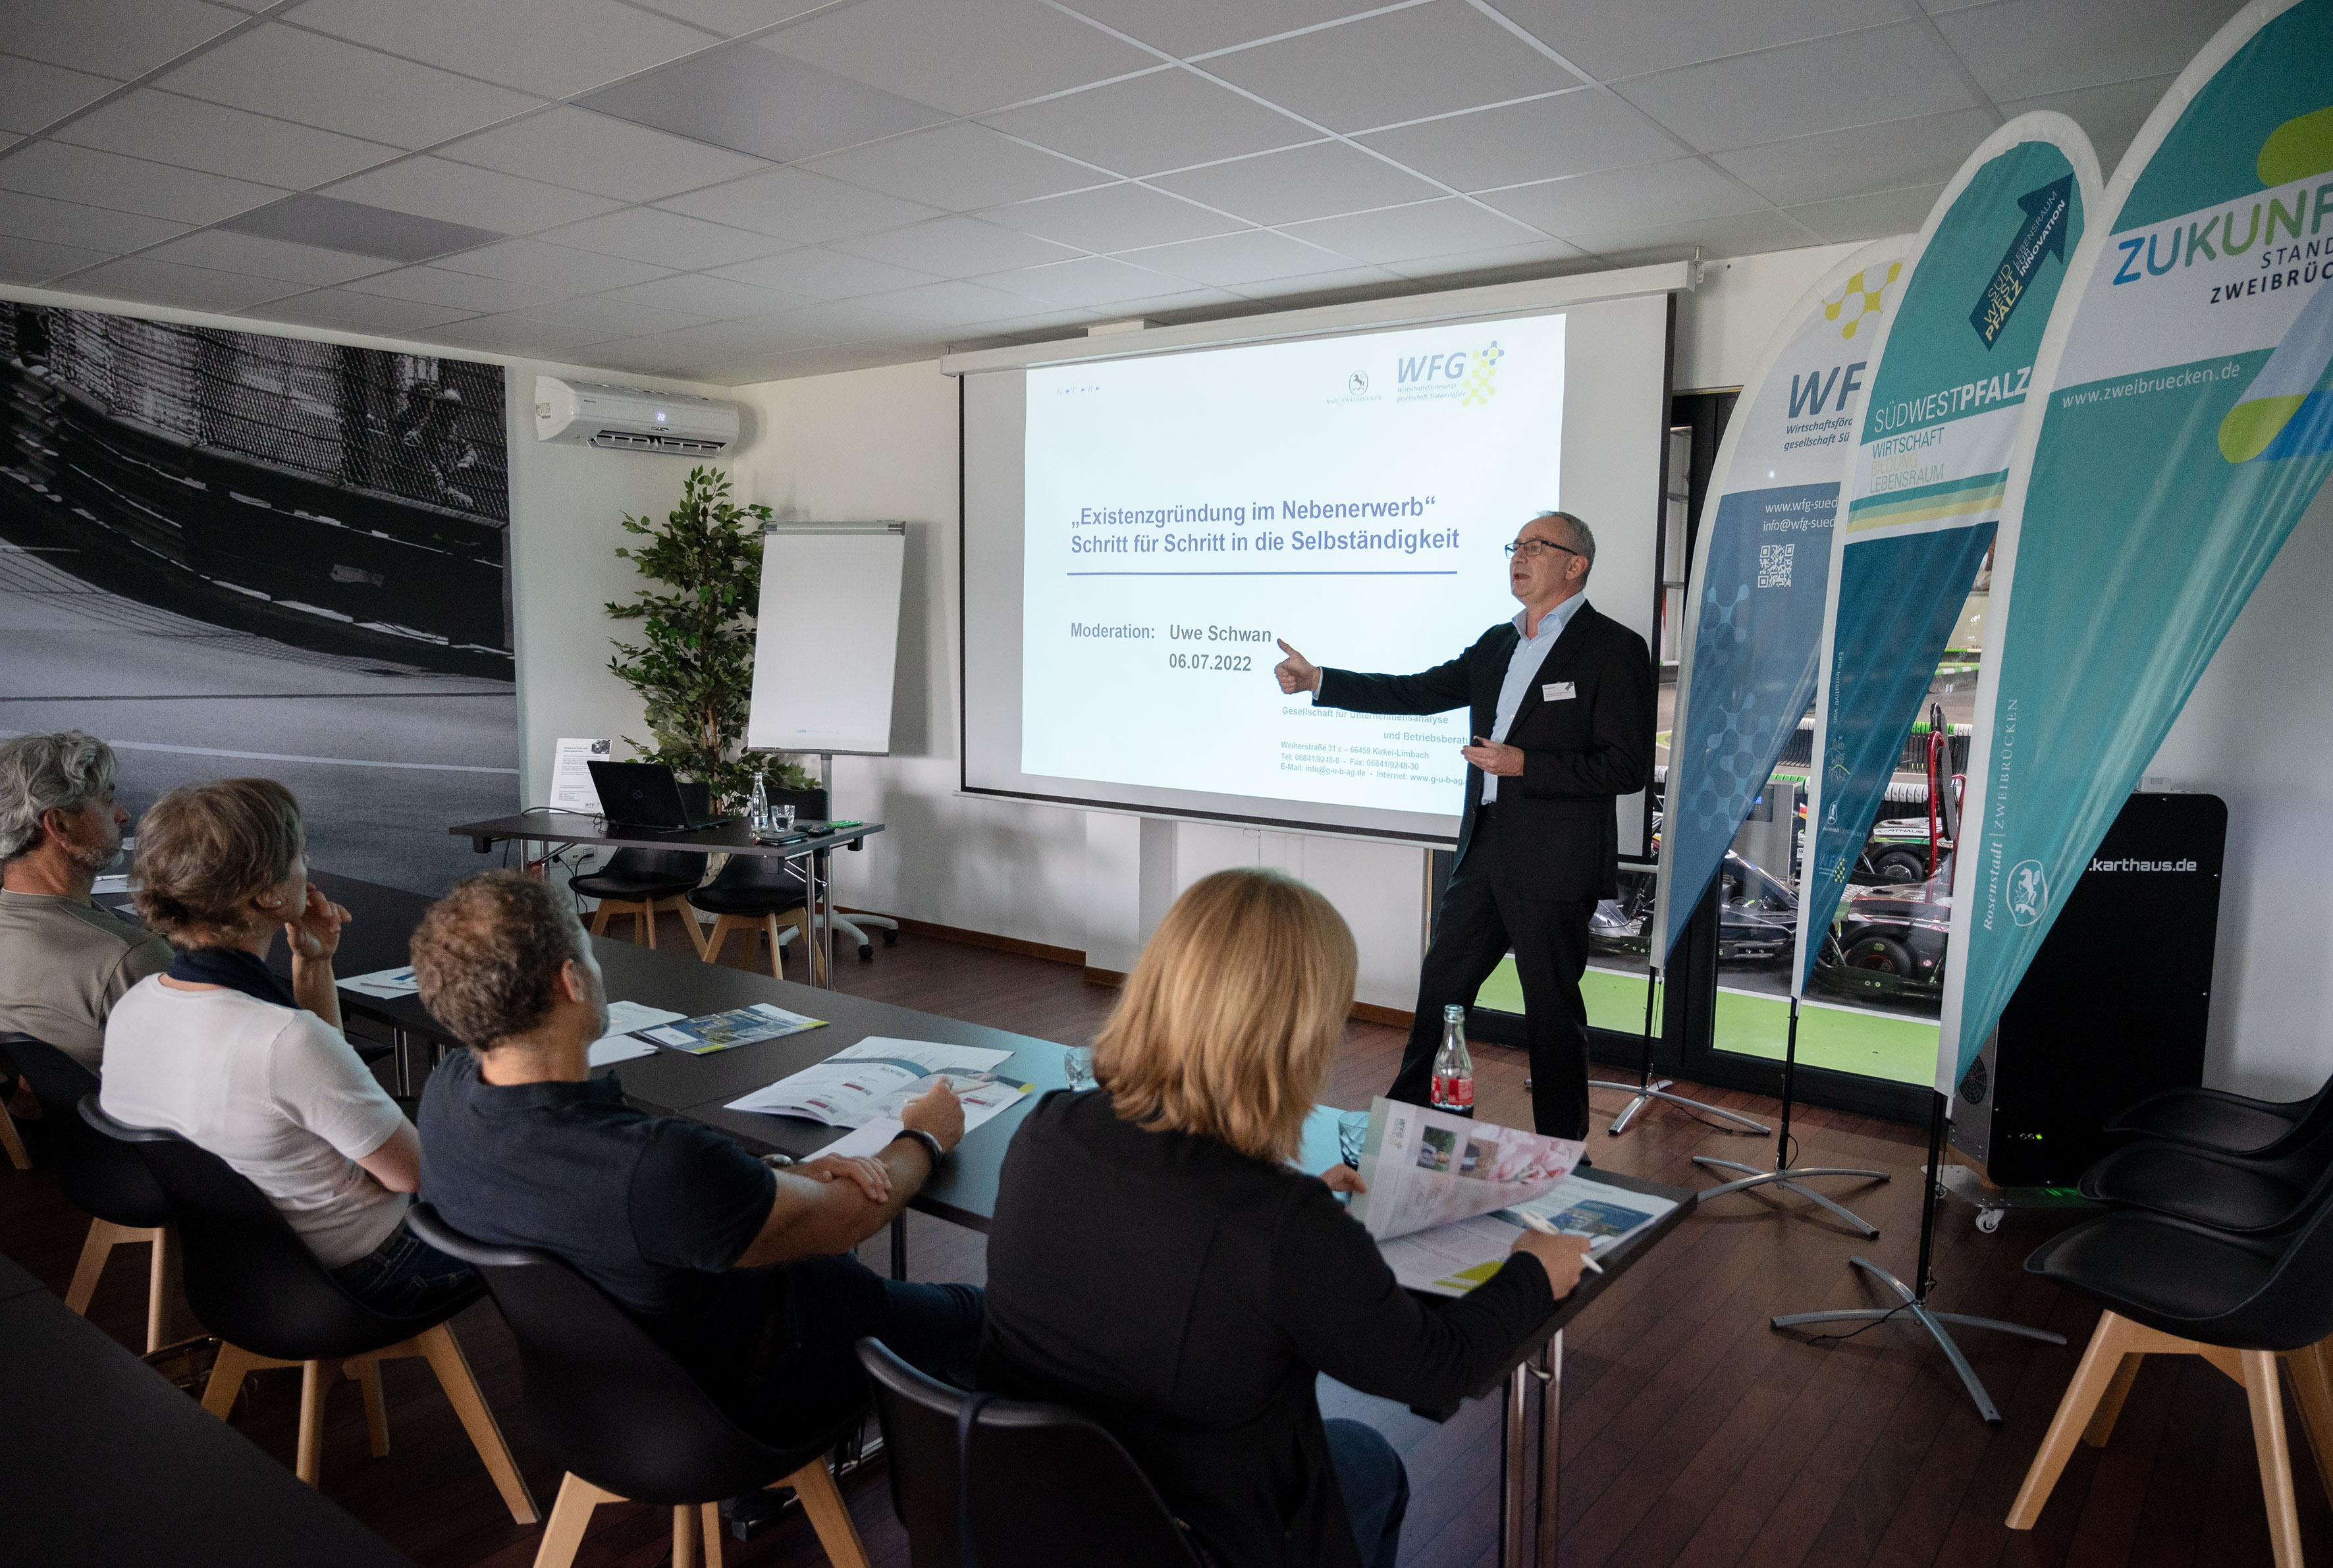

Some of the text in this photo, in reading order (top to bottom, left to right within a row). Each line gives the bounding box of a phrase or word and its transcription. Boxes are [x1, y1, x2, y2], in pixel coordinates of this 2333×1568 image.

[2012, 190, 2058, 266] LEBENSRAUM
[2019, 199, 2066, 277] INNOVATION
[2112, 183, 2333, 286] ZUKUNF
[2015, 248, 2031, 272] FÜR
[2261, 236, 2333, 269] STAND
[1983, 271, 2016, 323] WEST
[1987, 263, 2011, 302] SÜD
[2210, 261, 2333, 304] ZWEIBRÜC
[1985, 279, 2023, 342] PFALZ
[1397, 352, 1467, 384] WFG
[1788, 361, 1867, 419] WF
[1874, 366, 2031, 433] SÜDWESTPFALZ
[2062, 362, 2239, 408] www.zweibruecken.de
[1784, 433, 1837, 452] gesellschaft
[1872, 427, 1944, 460] WIRTSCHAFT
[1869, 463, 1945, 493] LEBENSRAUM
[1871, 450, 1918, 477] BILDUNG
[1071, 495, 1435, 529] „Existenzgründung im Nebenerwerb“
[1765, 496, 1838, 513] www.wfg-sued
[1071, 527, 1460, 554] Schritt für Schritt in die Selbständigkeit
[1071, 622, 1272, 642] Moderation: Uwe Schwan
[1169, 653, 1252, 672] 06.07.2022
[1282, 707, 1333, 717] Gesellschaft
[1335, 709, 1347, 718] für
[1281, 741, 1326, 751] Weiherstraße
[1372, 747, 1430, 759] Kirkel-Limbach
[1295, 754, 1339, 764] 06841/9248-0
[1366, 759, 1419, 770] 06841/9248-30
[1281, 763, 1304, 771] E-Mail:
[1306, 765, 1366, 777] info@g-u-b-ag.de
[1376, 770, 1408, 780] Internet:
[1410, 774, 1464, 786] www.g-u-b-ag.
[1983, 699, 2018, 931] Rosenstadt ZWEIBRÜCKEN
